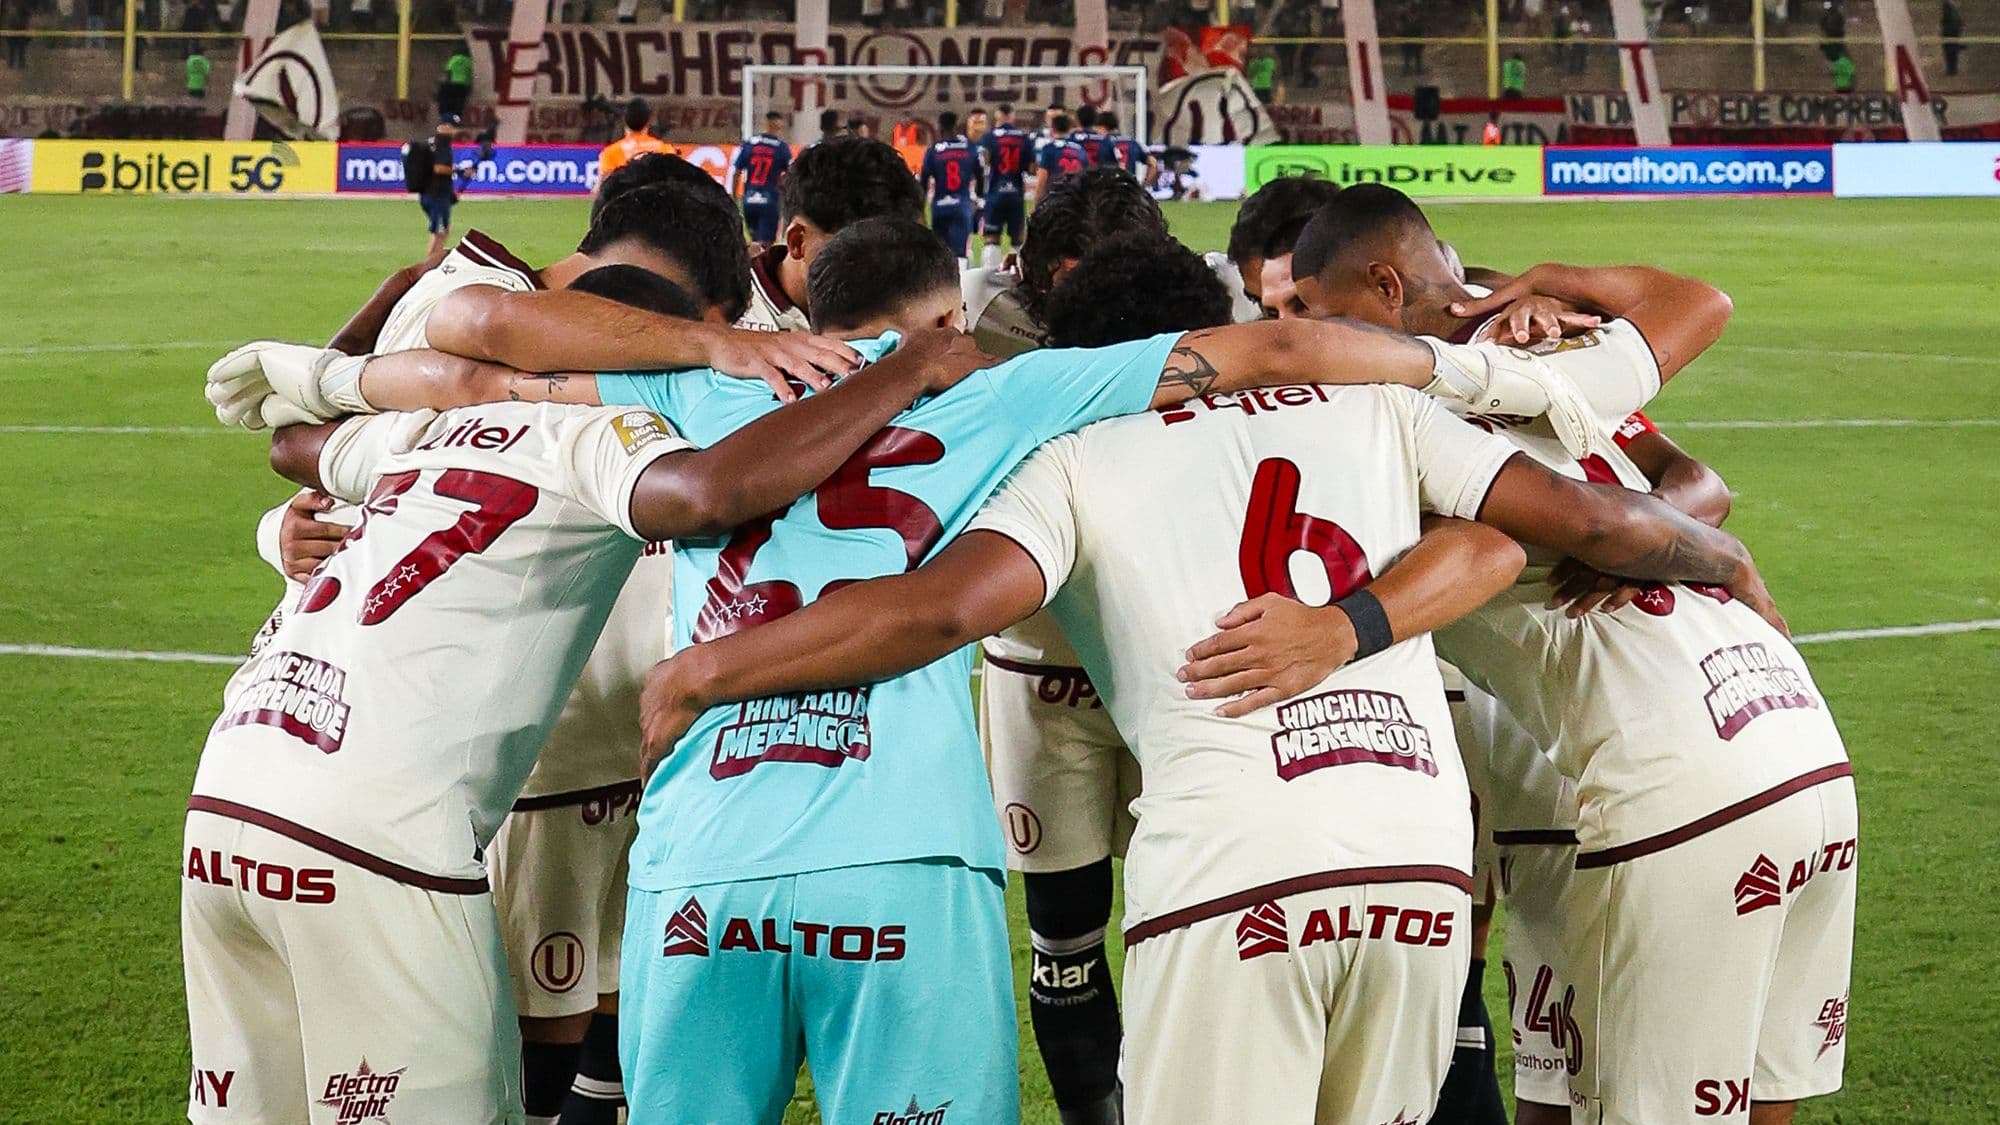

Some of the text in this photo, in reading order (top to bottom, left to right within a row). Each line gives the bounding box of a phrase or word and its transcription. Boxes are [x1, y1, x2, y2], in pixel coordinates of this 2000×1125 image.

[112, 153, 283, 191] bitel 5G
[946, 160, 961, 191] 8
[1342, 162, 1517, 183] inDrive
[1551, 157, 1826, 189] marathon.com.pe
[418, 417, 531, 453] itel
[1239, 457, 1374, 607] 6
[1282, 692, 1410, 729] HINCHADA
[188, 847, 336, 904] ALTOS
[719, 917, 906, 962] ALTOS
[1299, 905, 1455, 948] ALTOS
[1033, 953, 1098, 989] klar
[324, 1073, 400, 1099] Electro
[338, 1095, 390, 1125] light
